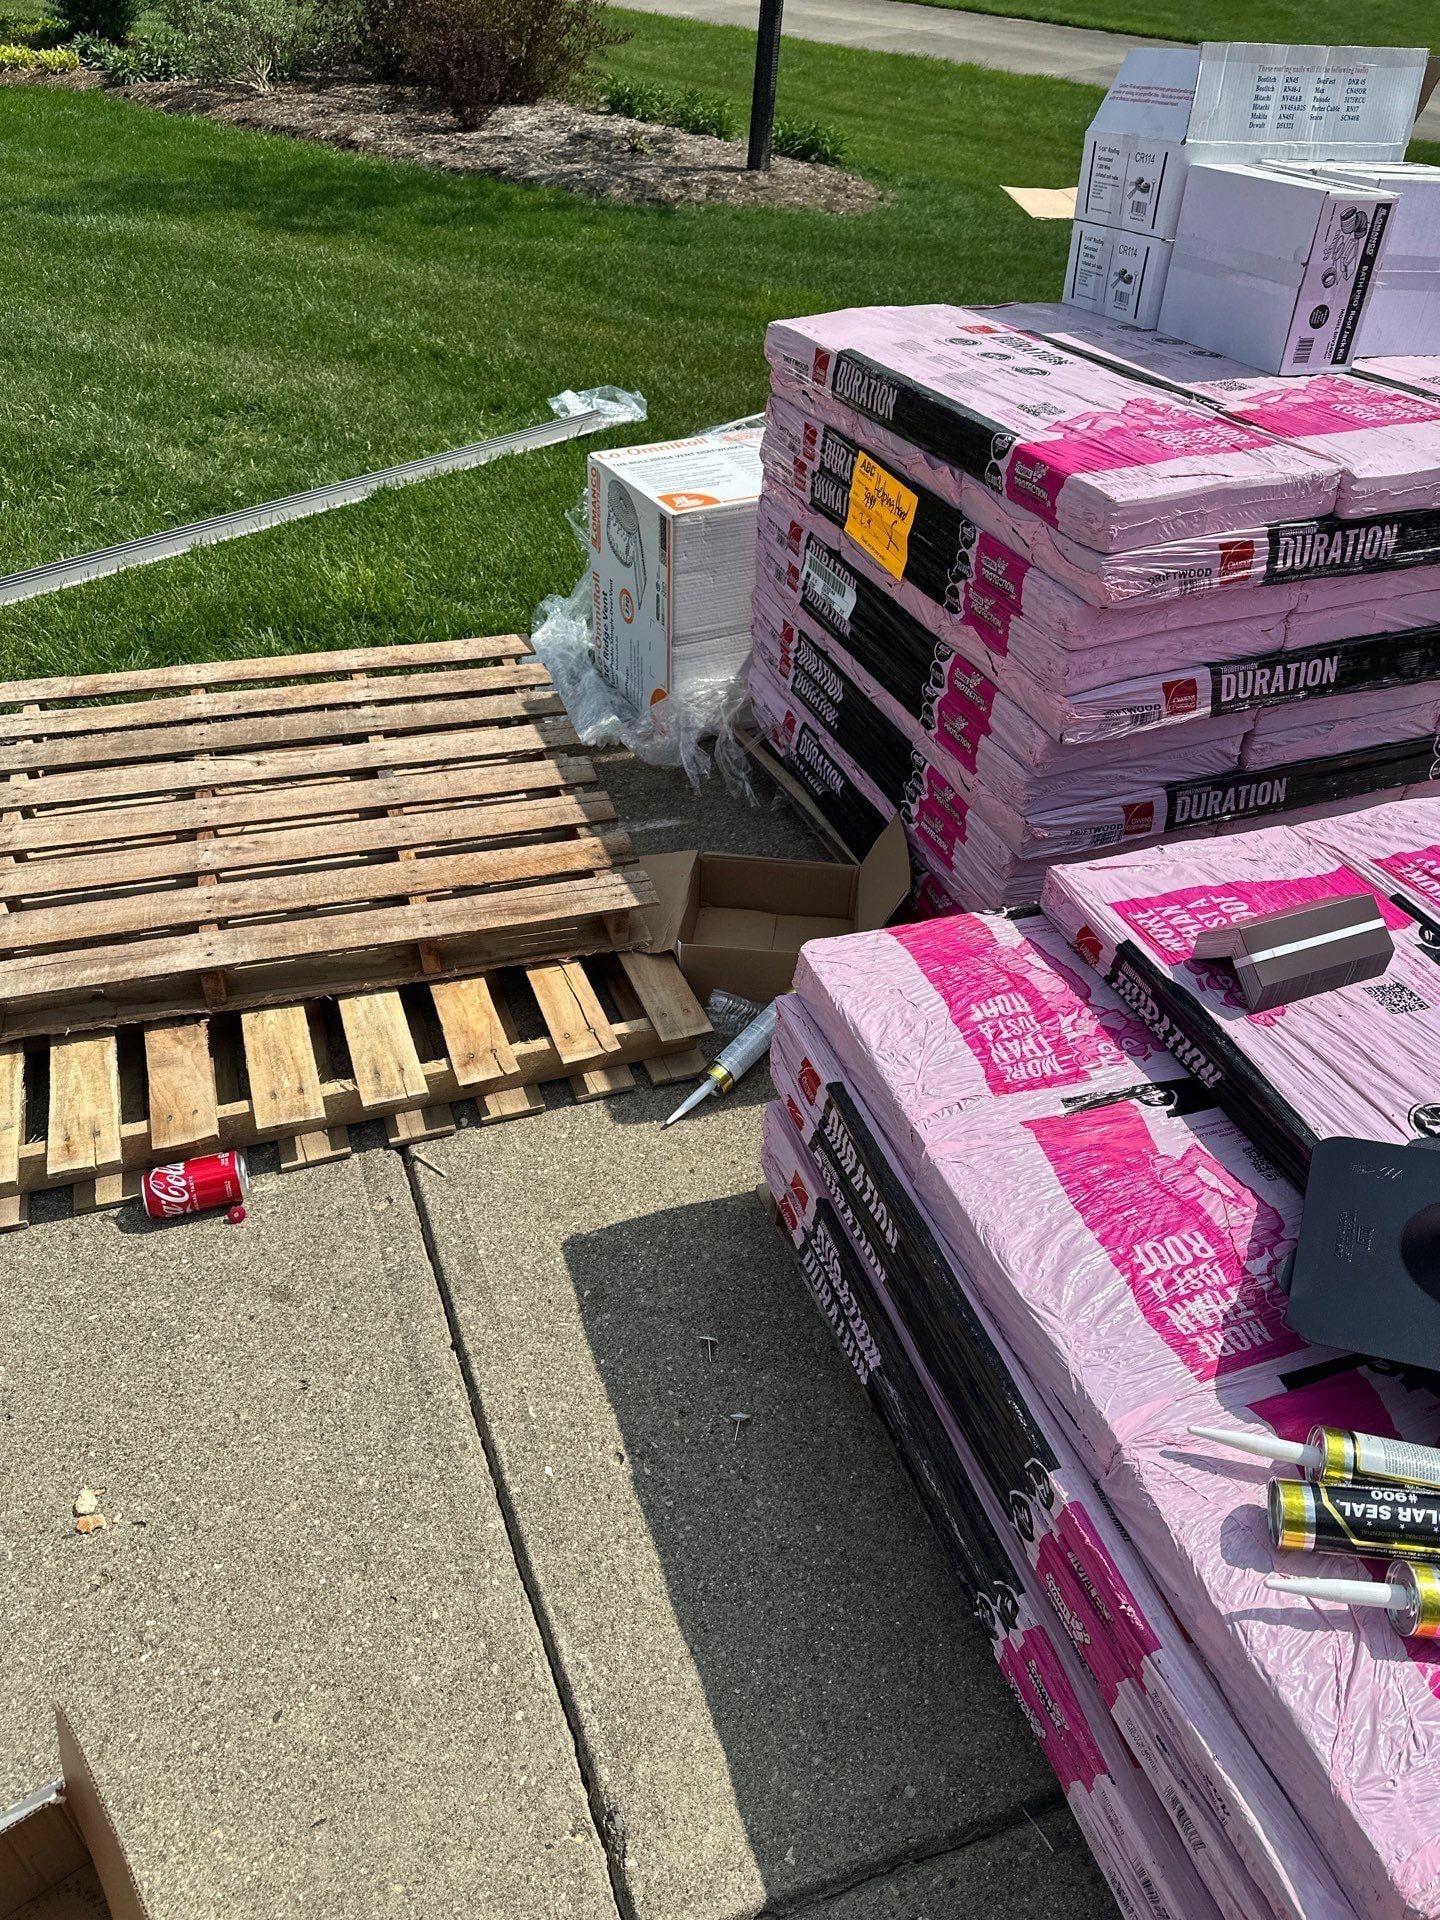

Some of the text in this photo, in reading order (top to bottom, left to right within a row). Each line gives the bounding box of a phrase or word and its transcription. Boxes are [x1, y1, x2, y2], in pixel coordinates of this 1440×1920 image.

[1135, 151, 1156, 164] CR114
[1118, 244, 1138, 258] CR114
[1334, 308, 1346, 331] MODEL
[1336, 265, 1369, 360] BATH PRO Roof Jack Kit
[836, 361, 898, 421] DURATION
[597, 437, 710, 460] Lo-OmniRoll
[674, 451, 696, 459] VENT
[698, 448, 717, 456] THAT
[718, 445, 745, 453] WORKS
[860, 459, 876, 477] ABC
[1014, 476, 1049, 500] PROTECTION
[590, 466, 600, 545] LOMANCO
[1277, 523, 1399, 573] DURATION
[980, 567, 1016, 594] PROTECTION
[1147, 567, 1213, 586] DRIFTWOOD
[970, 600, 1003, 630] PROTECTION
[602, 623, 611, 661] Ridge
[796, 640, 844, 704] DURATION
[1220, 655, 1340, 702] DURATION
[953, 678, 987, 707] PROTECTION
[1172, 694, 1197, 703] OWENS
[1102, 703, 1162, 719] DRIFTWOOD
[943, 721, 972, 751] PROTECTION
[799, 732, 845, 798] DURATION
[1174, 777, 1288, 823] DURATION
[1069, 822, 1124, 836] DRIFTWOOD
[1131, 815, 1152, 824] OWENS
[920, 820, 949, 853] PROTECTION
[1186, 897, 1212, 910] A
[1127, 907, 1190, 954] MORE
[969, 991, 1032, 1022] ROOF
[977, 1014, 1042, 1041] JUST A
[1110, 970, 1224, 1090] DURATION
[989, 1033, 1055, 1065] THAN
[1000, 1053, 1064, 1083] MORE
[823, 1106, 900, 1254] DURATION
[1131, 1230, 1217, 1276] ROOF
[1146, 1260, 1229, 1300] JUST A
[1187, 1317, 1274, 1363] MORE
[1370, 1490, 1419, 1504] #900
[1340, 1501, 1440, 1525] LAR SEAL
[1360, 1528, 1400, 1540] RESIDENTIAL
